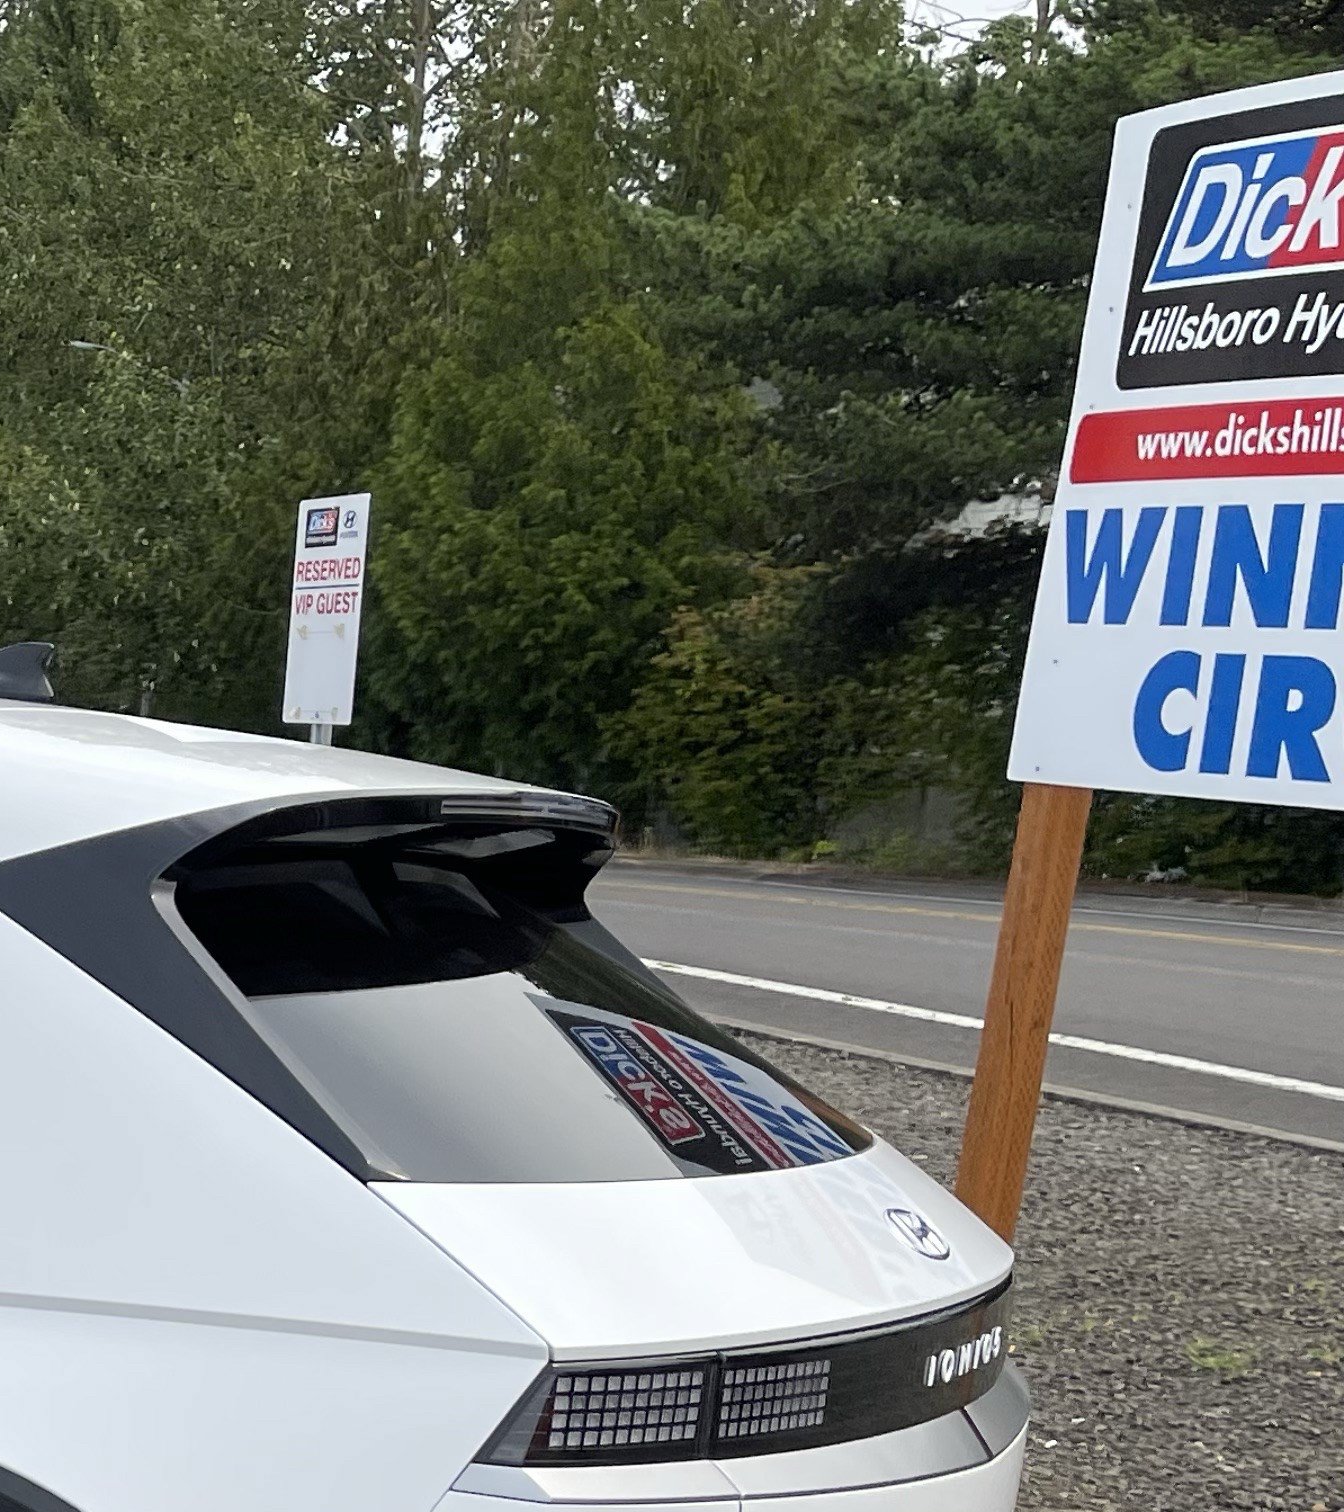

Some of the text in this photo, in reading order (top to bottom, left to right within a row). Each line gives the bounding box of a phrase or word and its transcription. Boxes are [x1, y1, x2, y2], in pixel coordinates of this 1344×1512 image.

[1127, 302, 1280, 356] Hillsboro
[1137, 407, 1344, 460] www.dickshill
[296, 557, 361, 583] RESERVED
[295, 592, 358, 615] VIP GUEST
[1133, 650, 1336, 783] CIR
